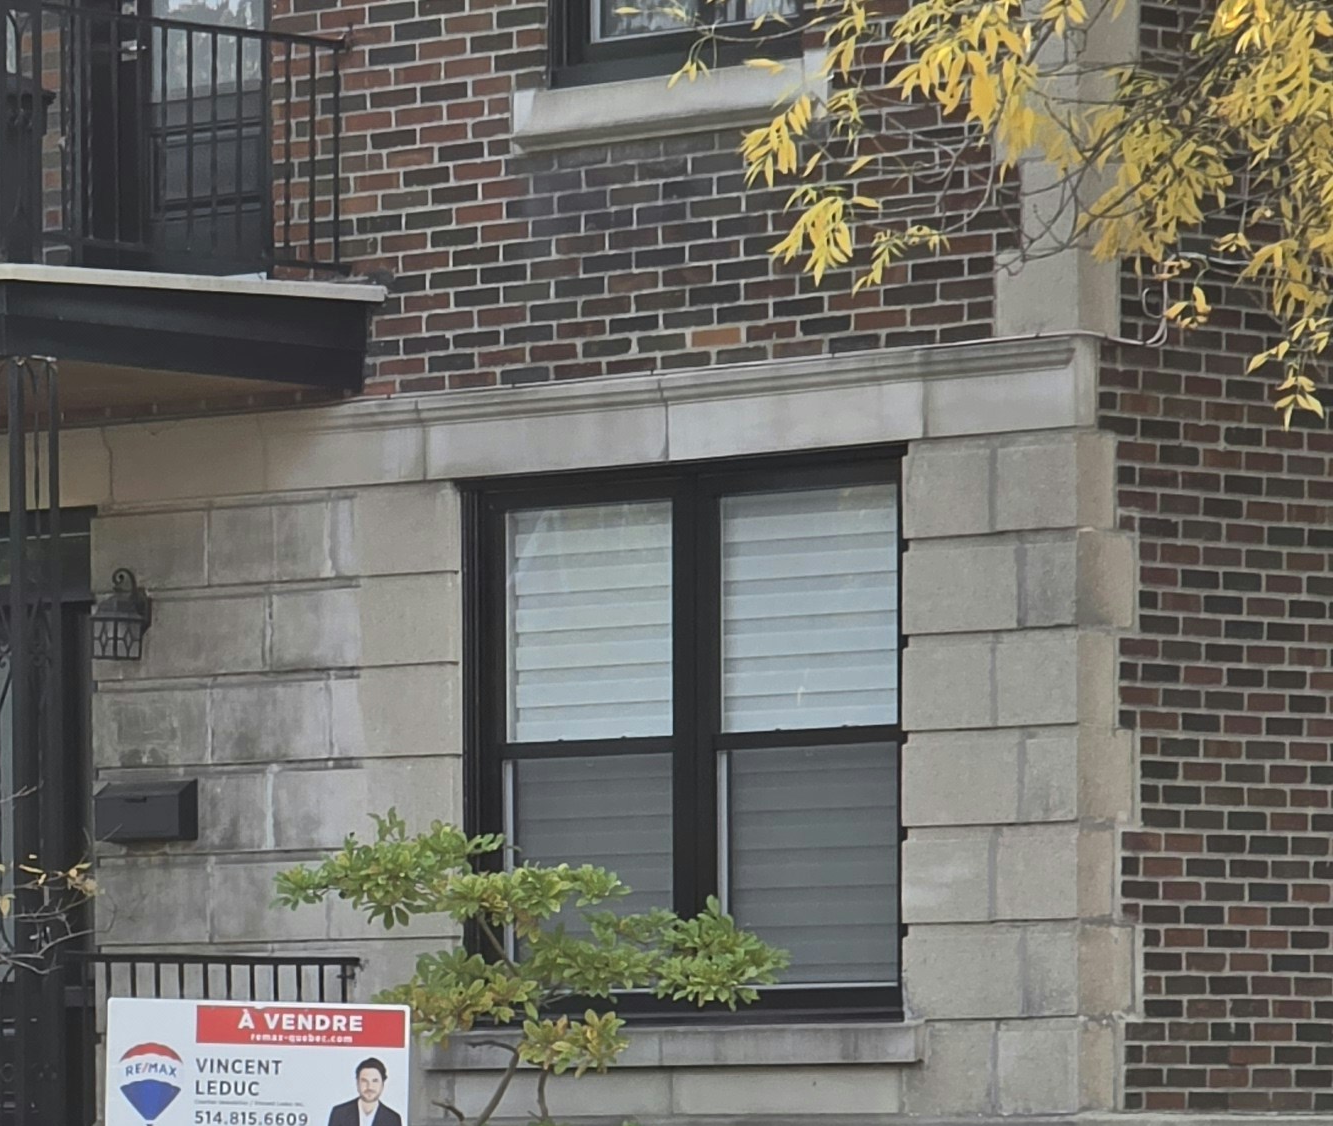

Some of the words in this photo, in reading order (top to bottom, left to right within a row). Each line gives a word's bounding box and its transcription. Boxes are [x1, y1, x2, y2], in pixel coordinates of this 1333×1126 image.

[237, 1009, 255, 1030] À
[264, 1012, 363, 1032] VENDRE
[125, 1062, 178, 1078] RE/MAX
[195, 1058, 283, 1076] VINCENT
[195, 1080, 260, 1096] LEDUC
[194, 1110, 309, 1126] 514.815.6609
